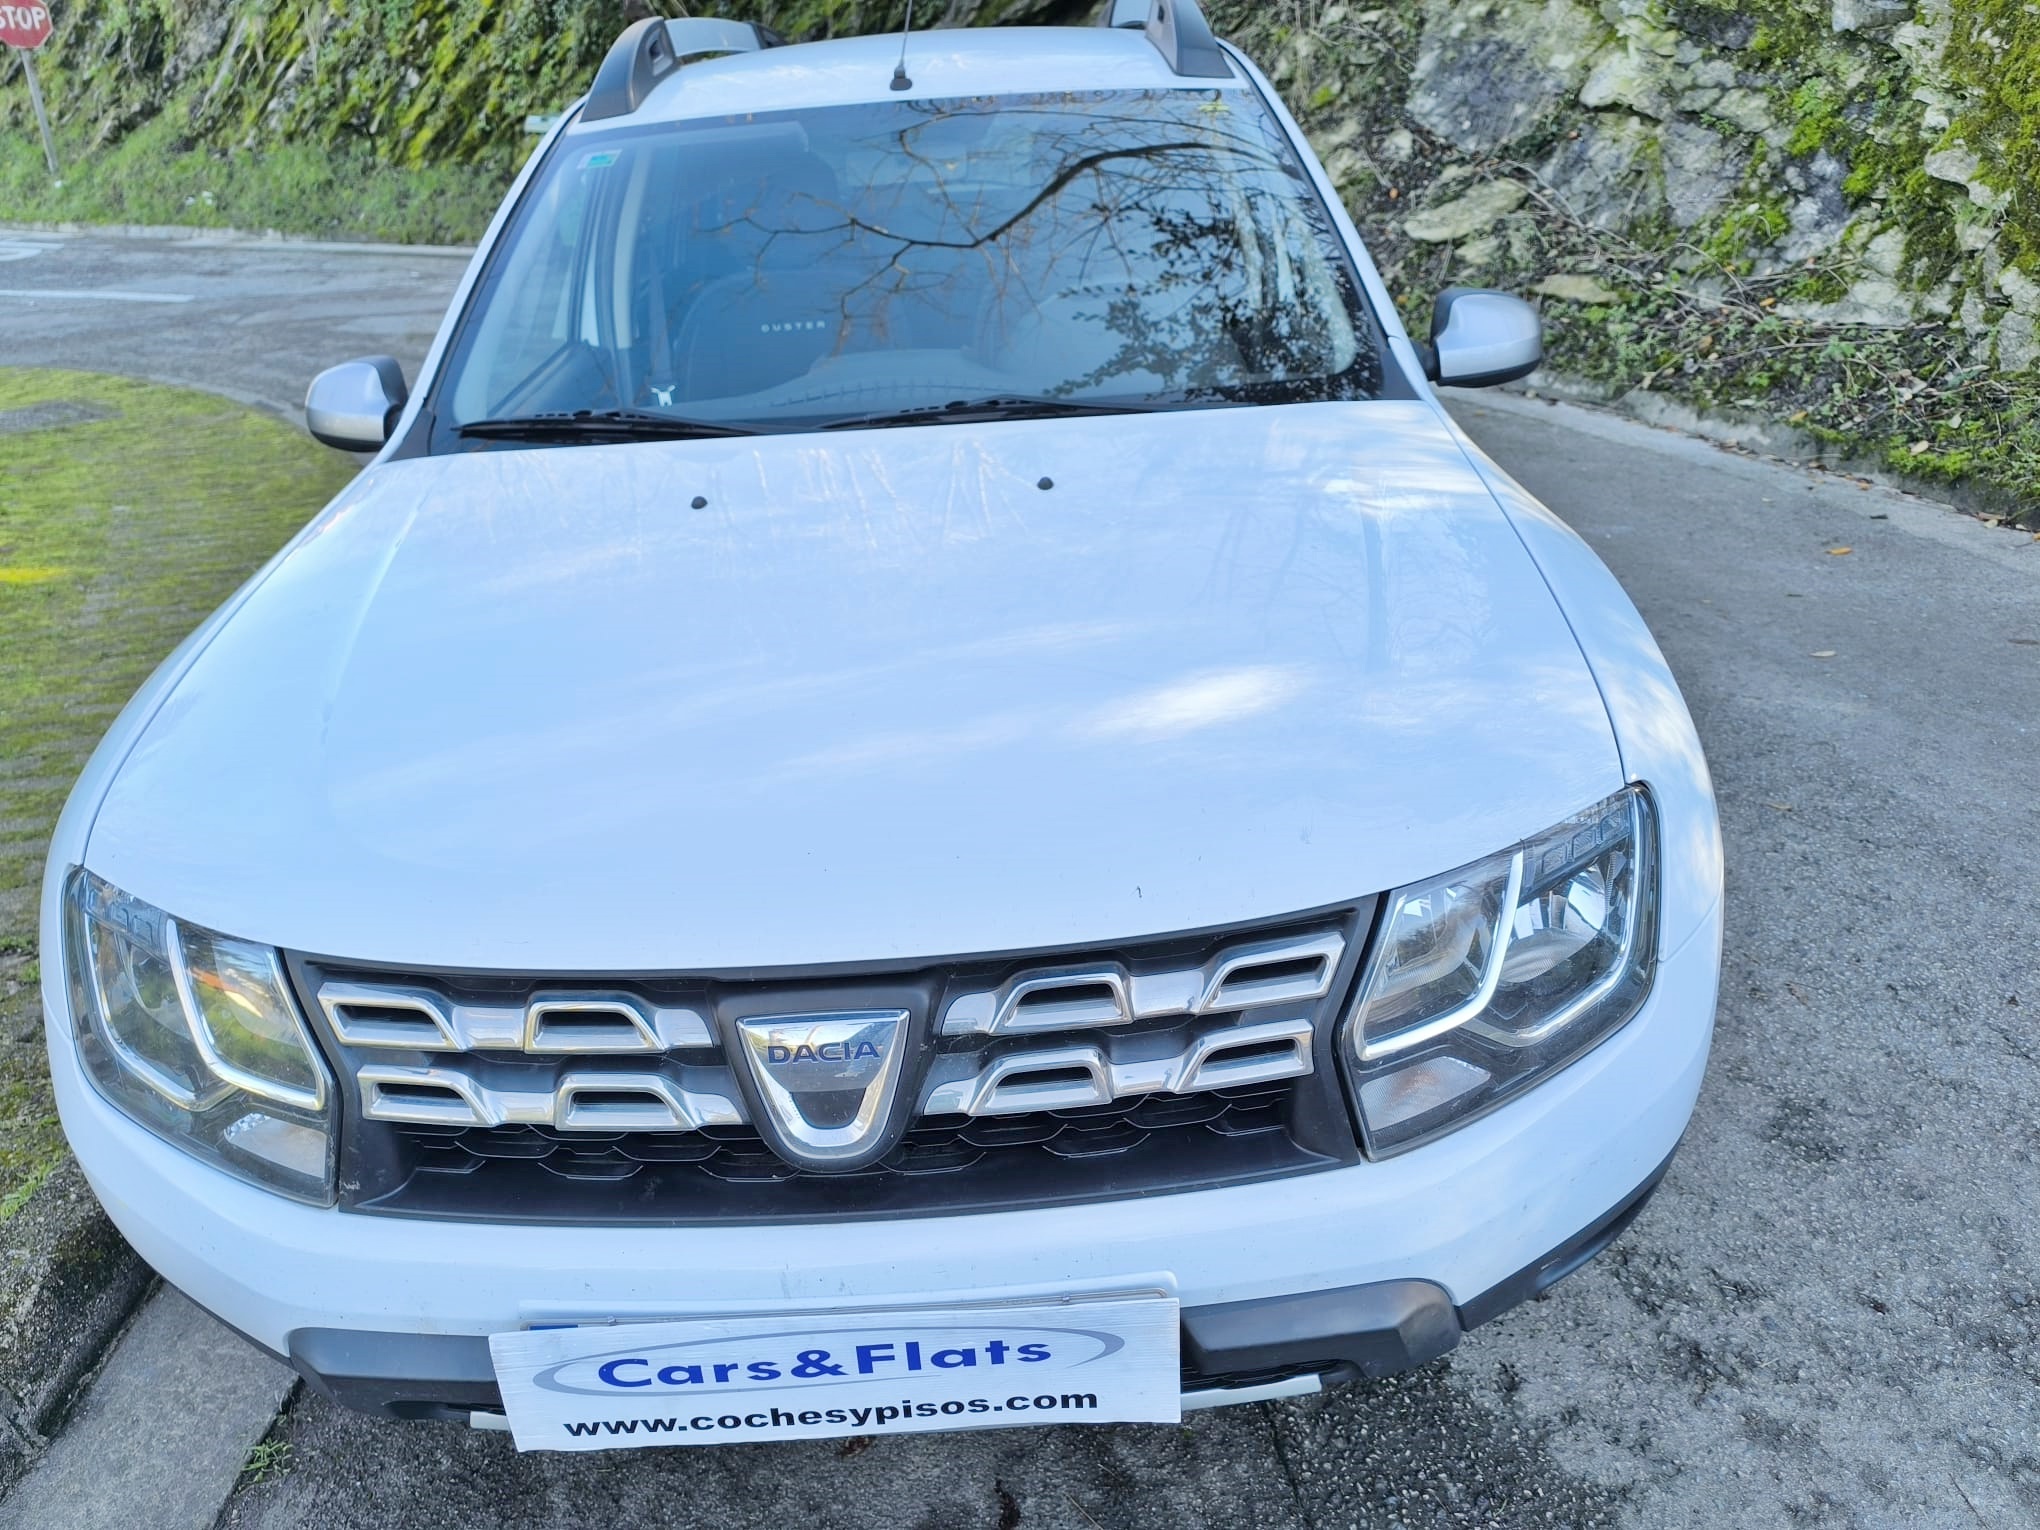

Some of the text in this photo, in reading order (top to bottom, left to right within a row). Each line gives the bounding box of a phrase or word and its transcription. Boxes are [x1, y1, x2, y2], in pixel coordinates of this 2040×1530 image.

[761, 321, 826, 333] DUSTER
[768, 1041, 881, 1064] DACIA
[599, 1340, 1052, 1388] Cars&Flats
[564, 1390, 1098, 1437] www.cochesypisos.com
